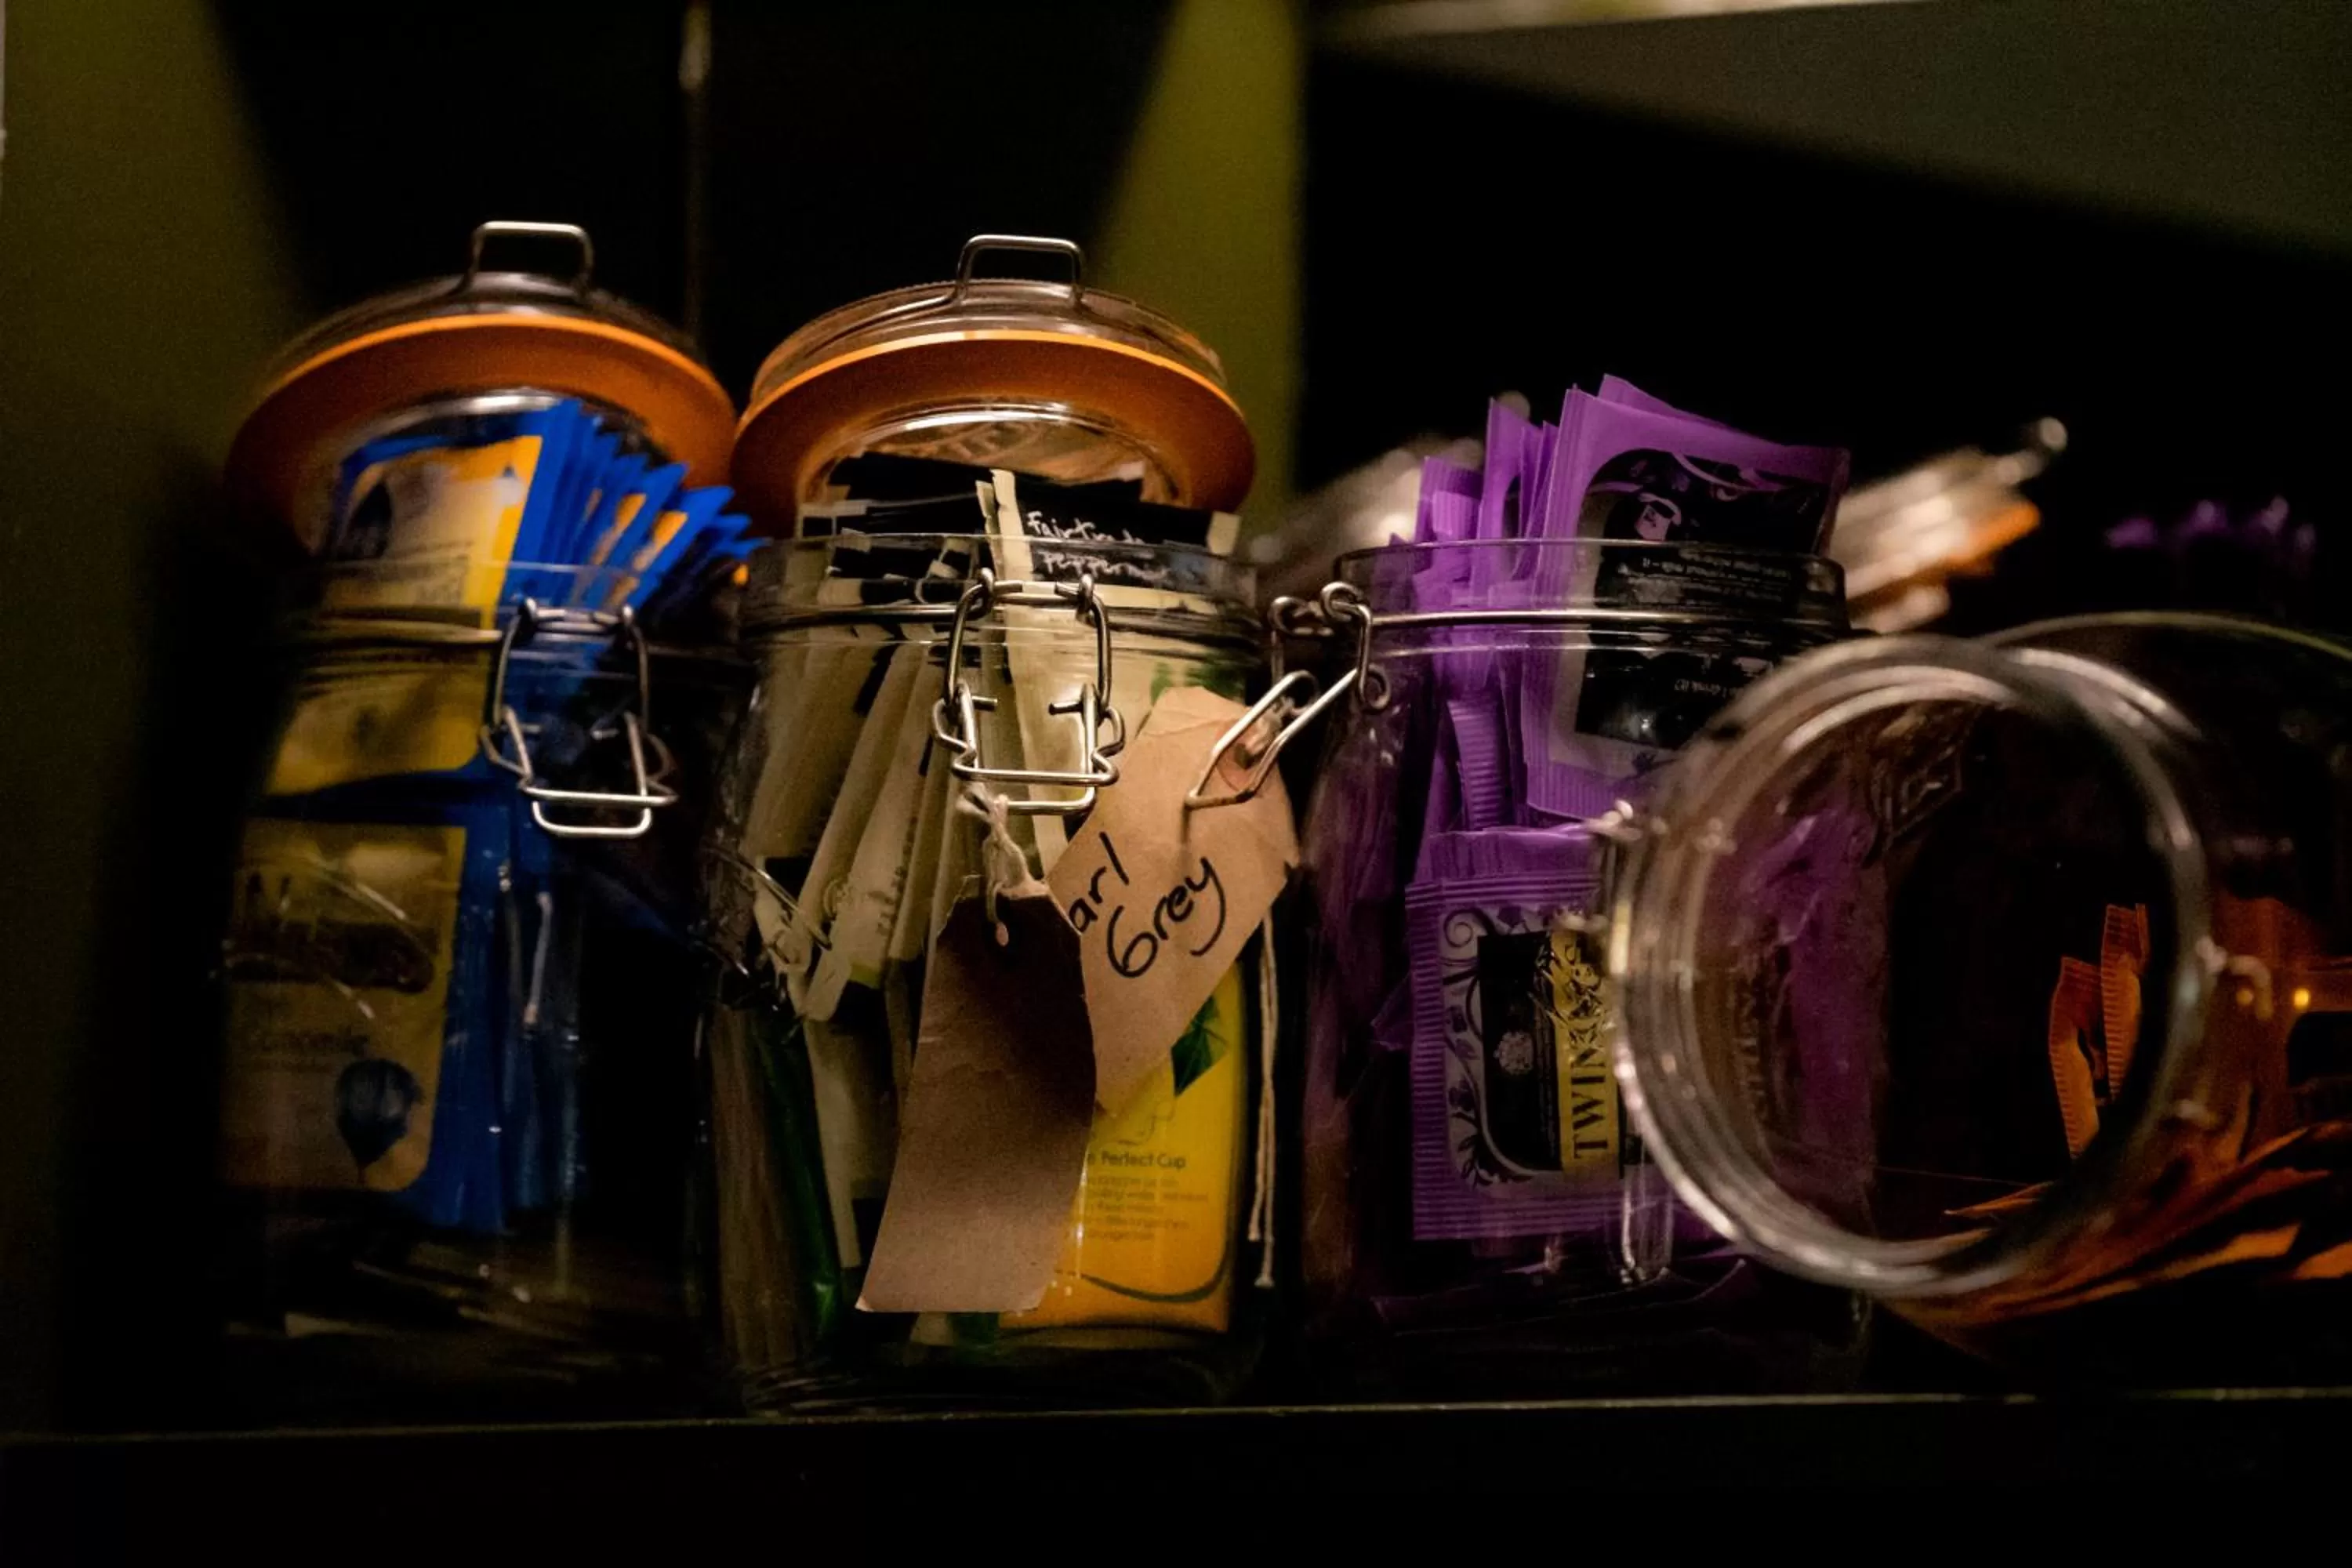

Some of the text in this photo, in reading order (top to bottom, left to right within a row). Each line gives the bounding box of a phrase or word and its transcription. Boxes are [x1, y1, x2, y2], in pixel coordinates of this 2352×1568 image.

[1069, 831, 1130, 933] arl
[1106, 857, 1226, 978] Grey
[1101, 1150, 1154, 1167] Perfect
[1156, 1152, 1186, 1172] Cup
